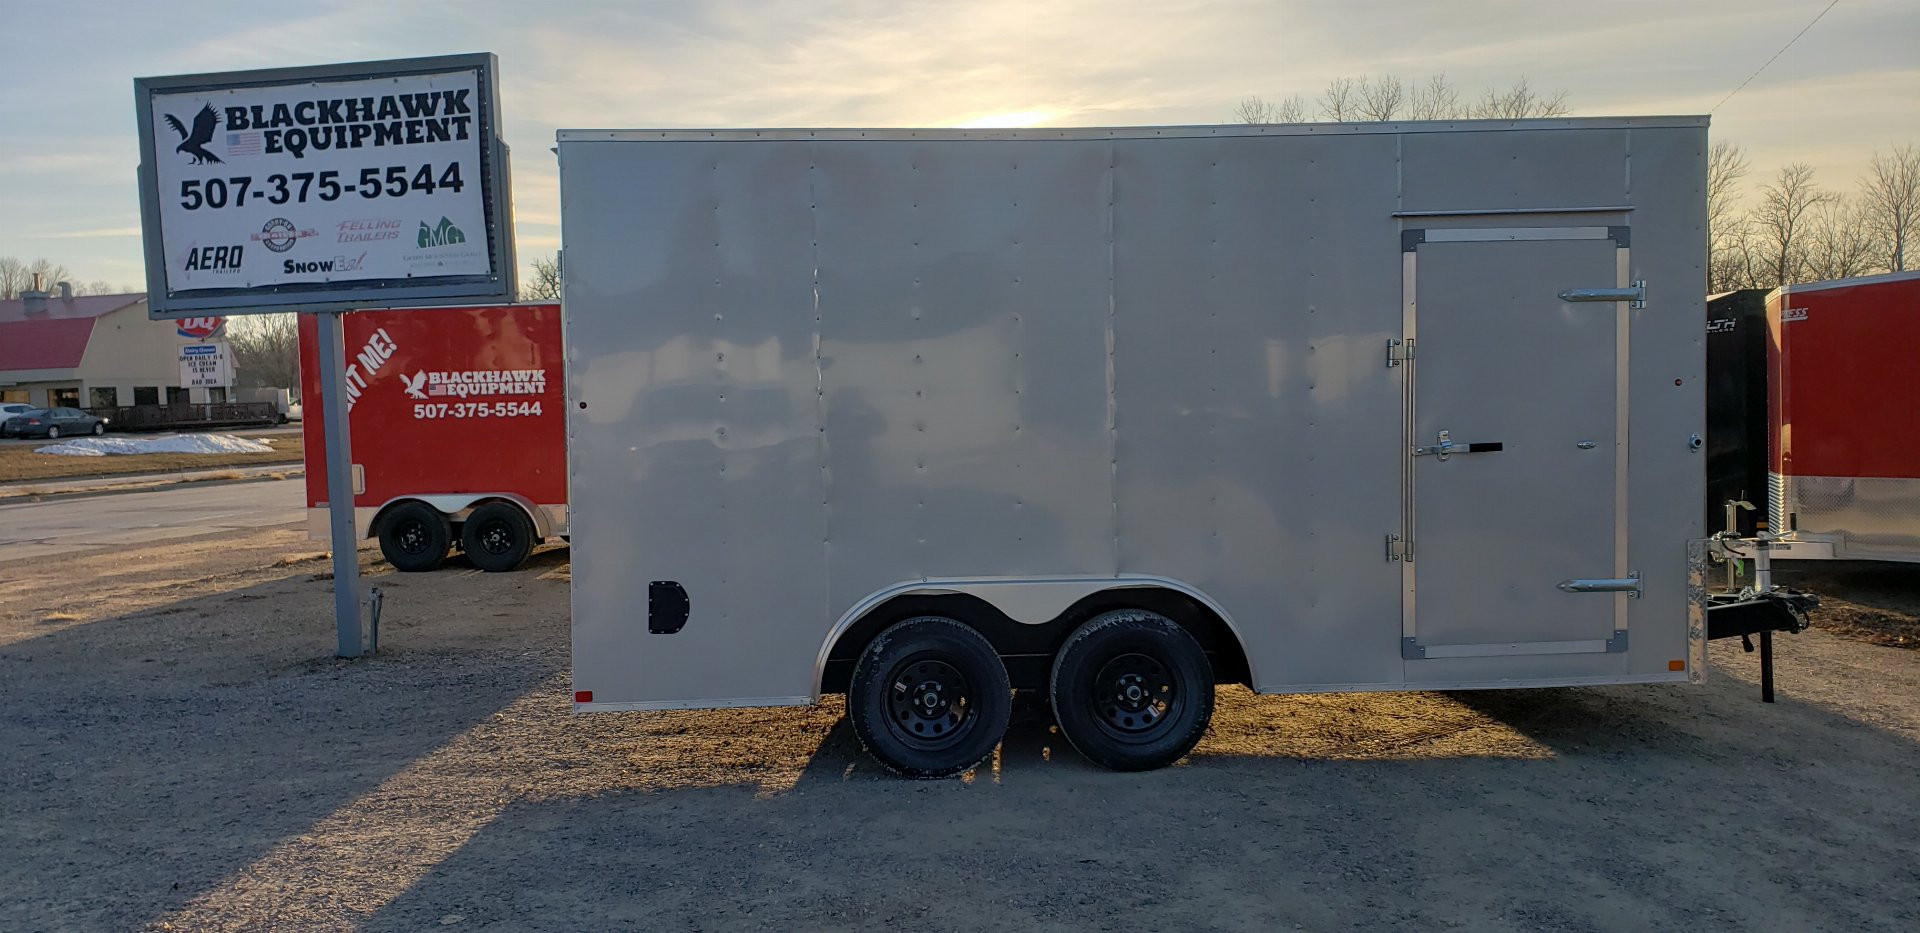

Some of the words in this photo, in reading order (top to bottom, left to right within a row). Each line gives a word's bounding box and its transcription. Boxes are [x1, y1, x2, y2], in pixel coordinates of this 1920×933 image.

[225, 89, 471, 131] BLACKHAWK
[264, 116, 472, 158] EQUIPMENT
[181, 162, 464, 210] 507-375-5544
[336, 219, 401, 231] FELLING
[337, 231, 400, 243] TRAILERS
[417, 224, 461, 250] GMG
[185, 245, 243, 271] AERO
[184, 317, 214, 330] DQ
[356, 327, 398, 376] ME!
[428, 369, 546, 384] BLACKHAWK
[447, 381, 546, 398] EQUIPMENT
[414, 402, 542, 419] 507-375-5544
